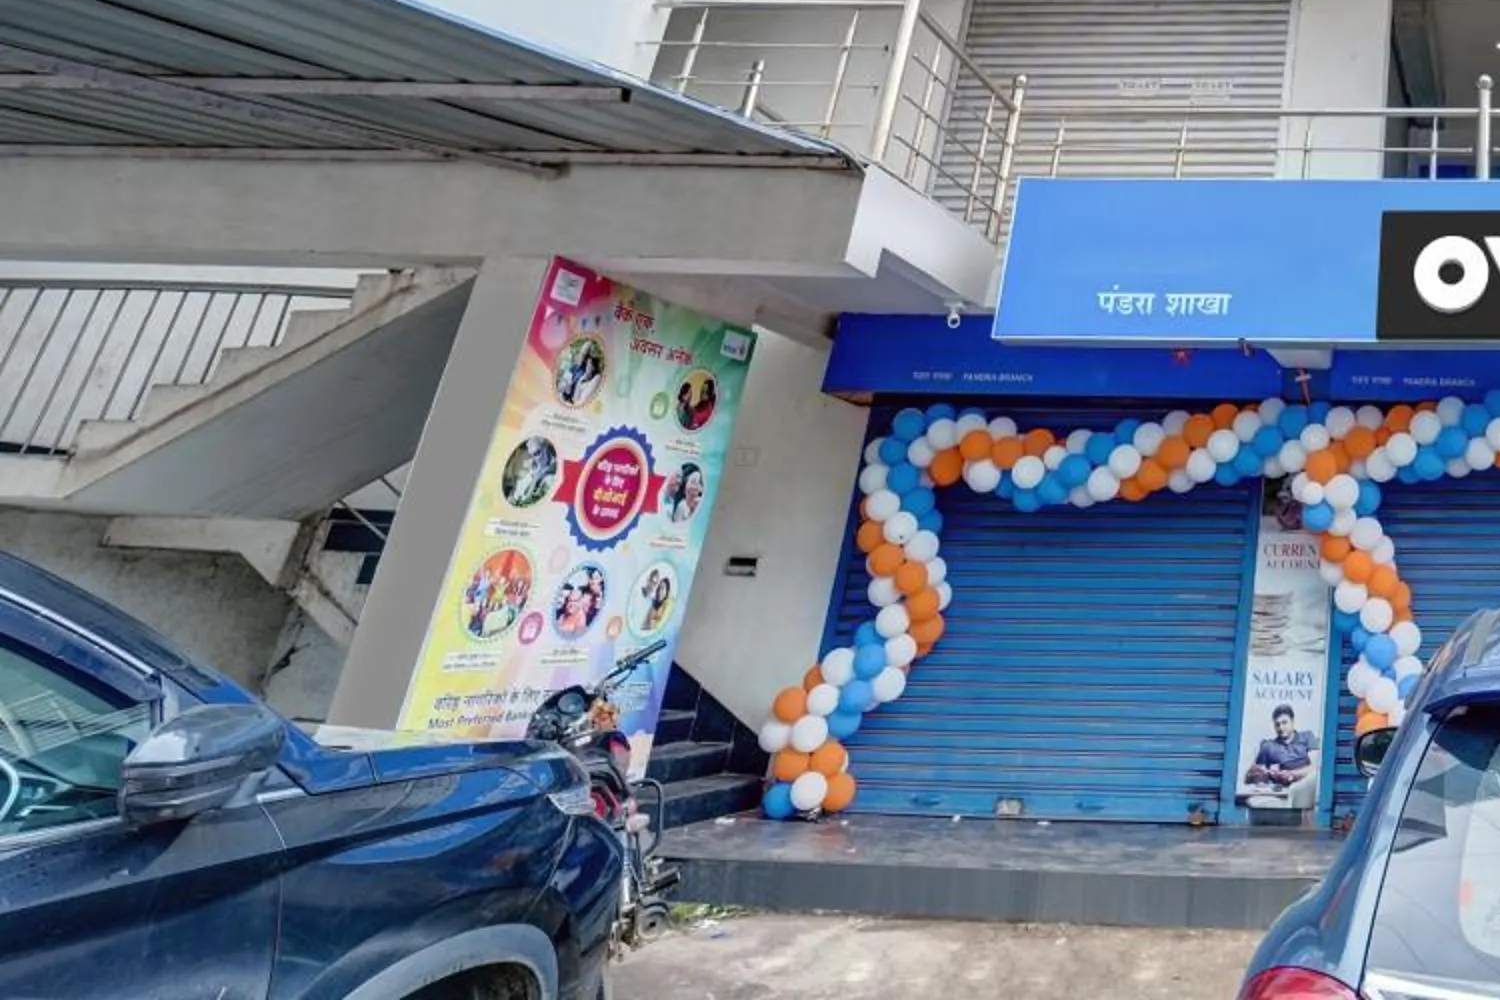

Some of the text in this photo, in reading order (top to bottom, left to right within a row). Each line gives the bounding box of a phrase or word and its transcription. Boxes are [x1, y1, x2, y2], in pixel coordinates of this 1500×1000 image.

[1097, 284, 1232, 316] पंडरा शाखा
[1263, 543, 1318, 557] CURREN
[1253, 671, 1314, 686] SALARY
[1255, 687, 1312, 701] ACCOUNT
[428, 716, 454, 730] Most
[457, 712, 502, 727] Preferred
